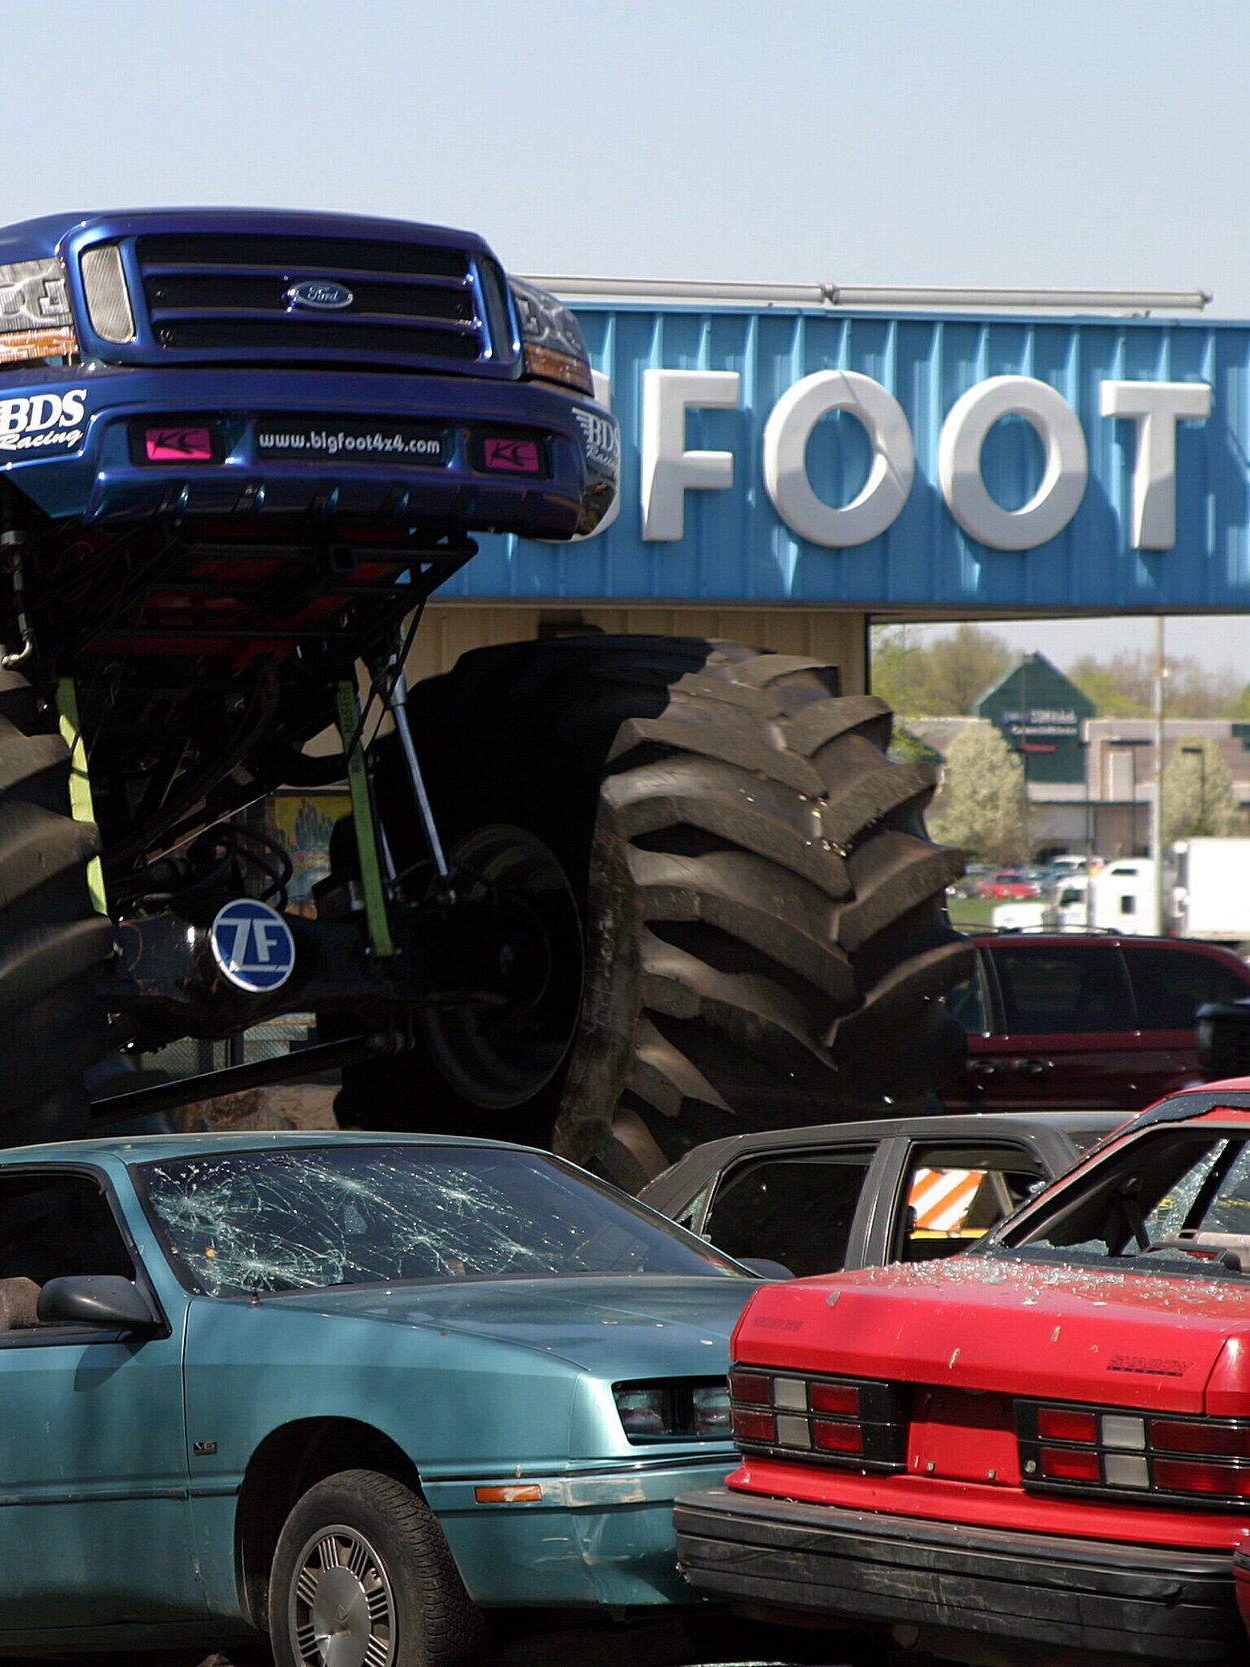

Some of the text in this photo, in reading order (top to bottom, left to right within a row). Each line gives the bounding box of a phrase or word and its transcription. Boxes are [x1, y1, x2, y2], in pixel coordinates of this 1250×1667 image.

[258, 431, 441, 455] www.bigfoot4x4.com
[638, 368, 1212, 552] FOOT
[214, 918, 288, 972] ZF
